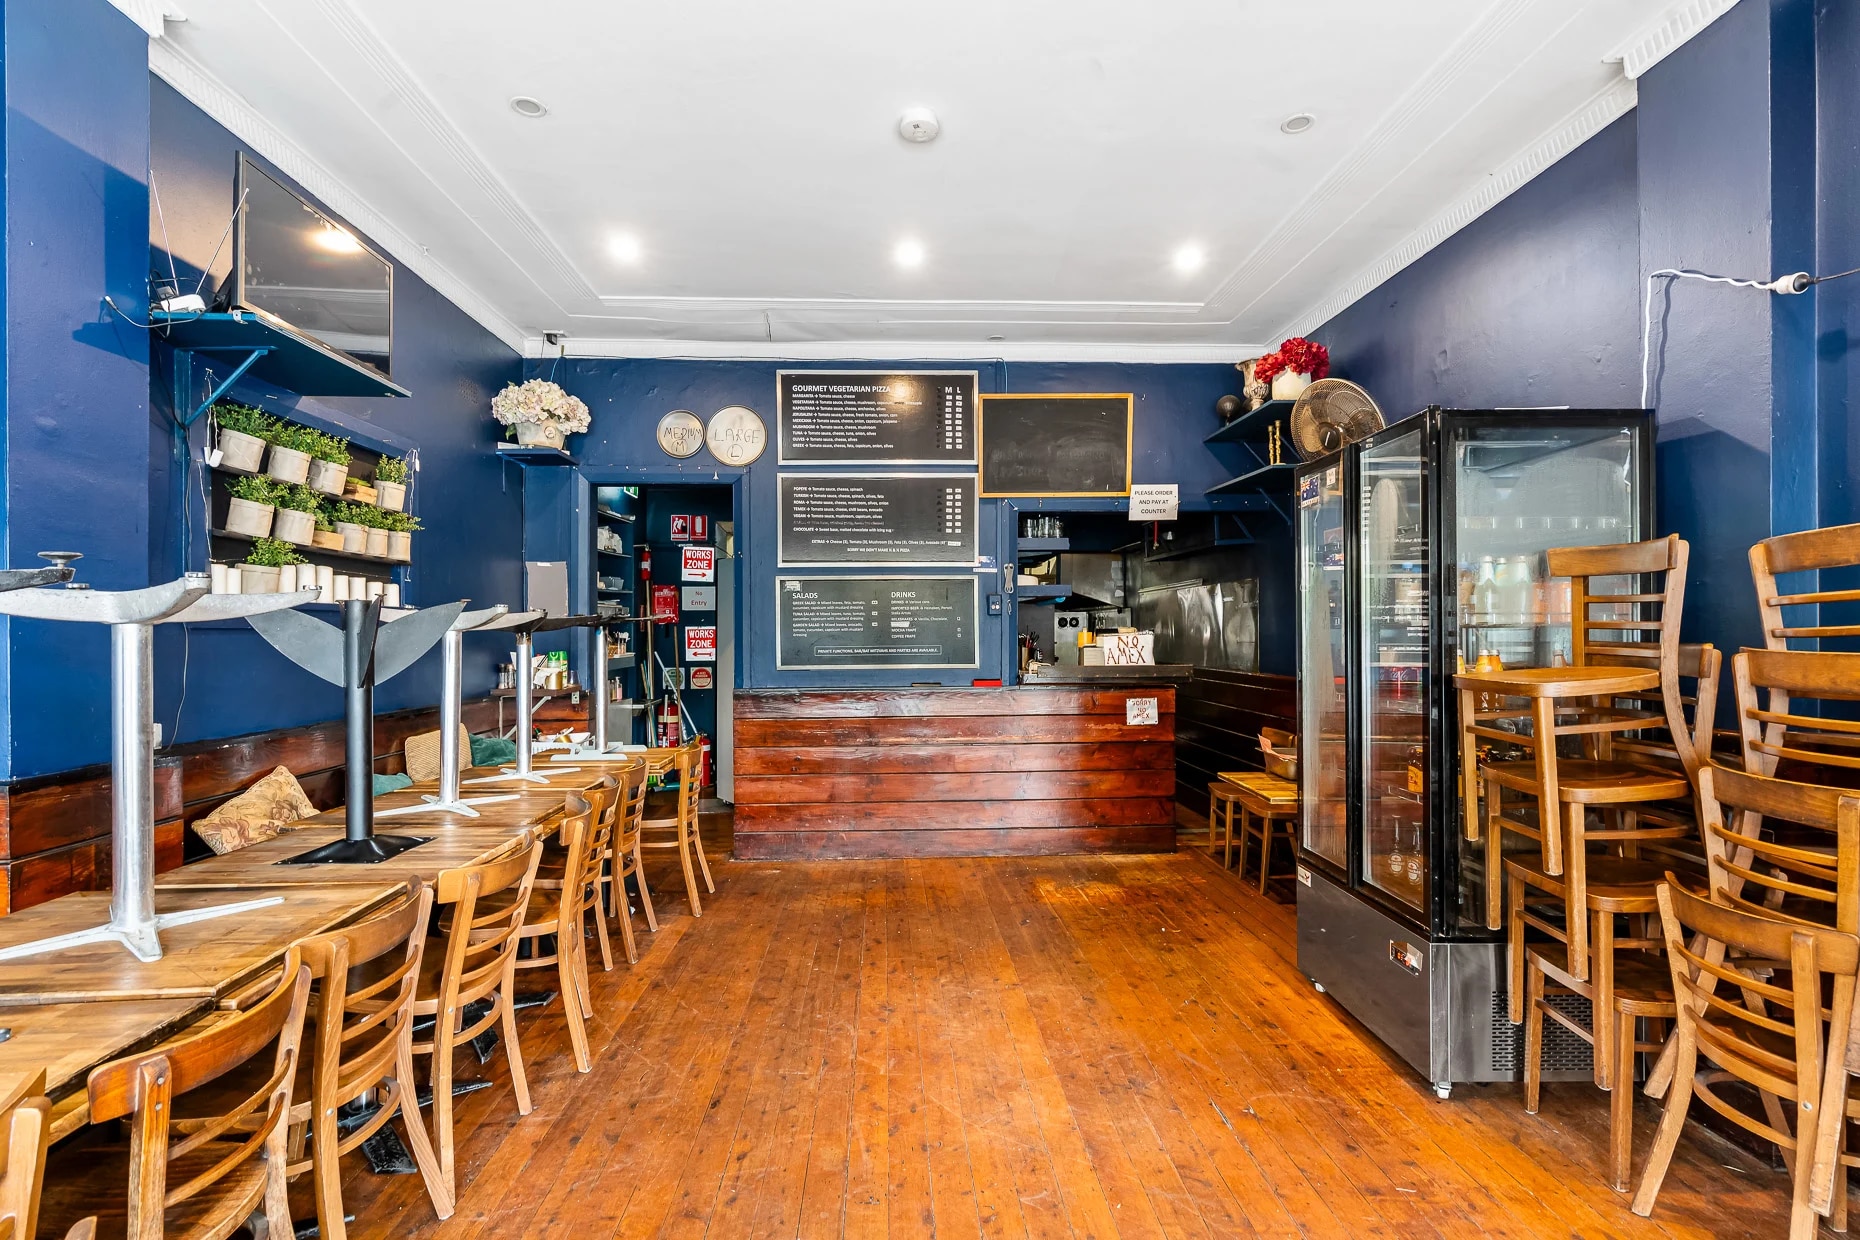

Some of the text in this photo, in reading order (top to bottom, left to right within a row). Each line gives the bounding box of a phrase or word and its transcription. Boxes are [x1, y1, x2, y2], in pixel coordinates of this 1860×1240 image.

[664, 427, 702, 440] MEDIUM
[714, 428, 760, 443] LARGE
[676, 441, 684, 452] M
[731, 446, 739, 457] L
[686, 550, 710, 559] WORKS
[687, 560, 709, 568] ZONE
[689, 630, 714, 638] WORKS
[1118, 636, 1139, 649] NO
[1107, 646, 1146, 664] AMEX
